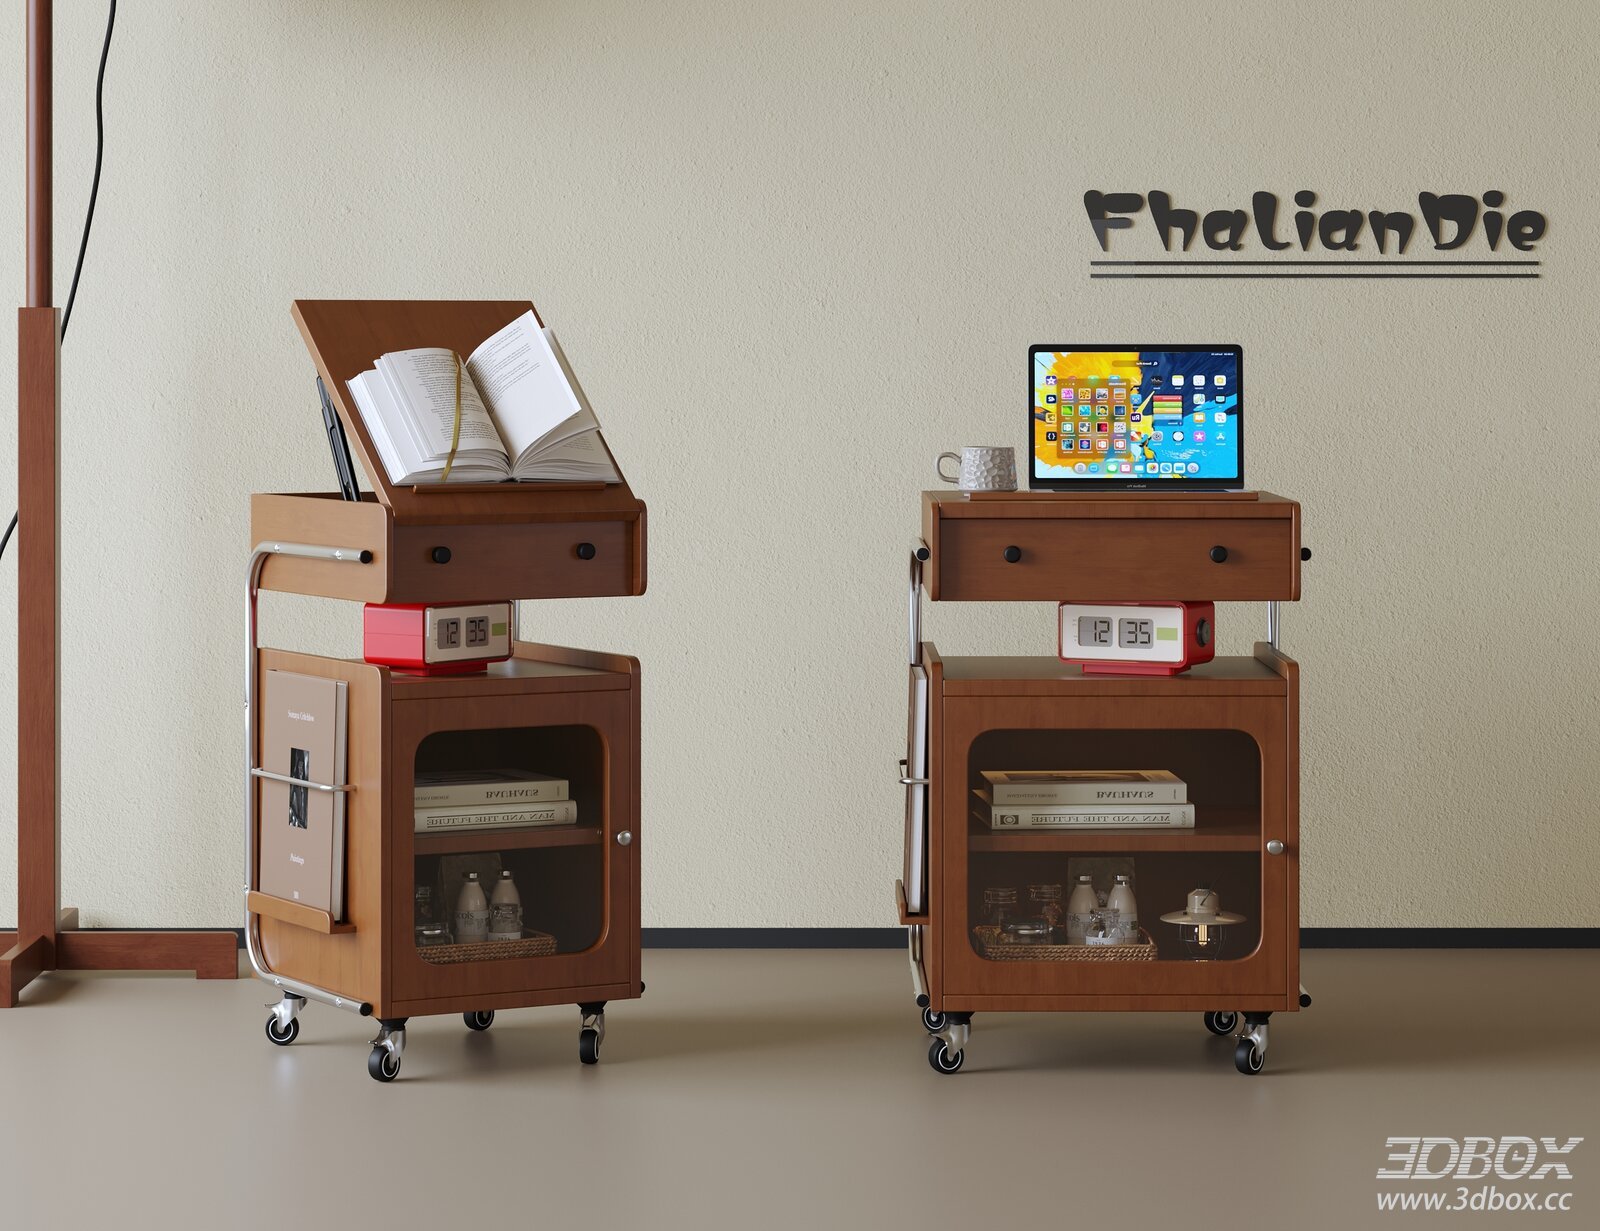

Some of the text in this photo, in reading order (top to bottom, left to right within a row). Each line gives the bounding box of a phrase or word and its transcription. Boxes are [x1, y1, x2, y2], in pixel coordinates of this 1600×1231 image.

[446, 619, 486, 645] 12 35
[1094, 620, 1151, 645] 12 35
